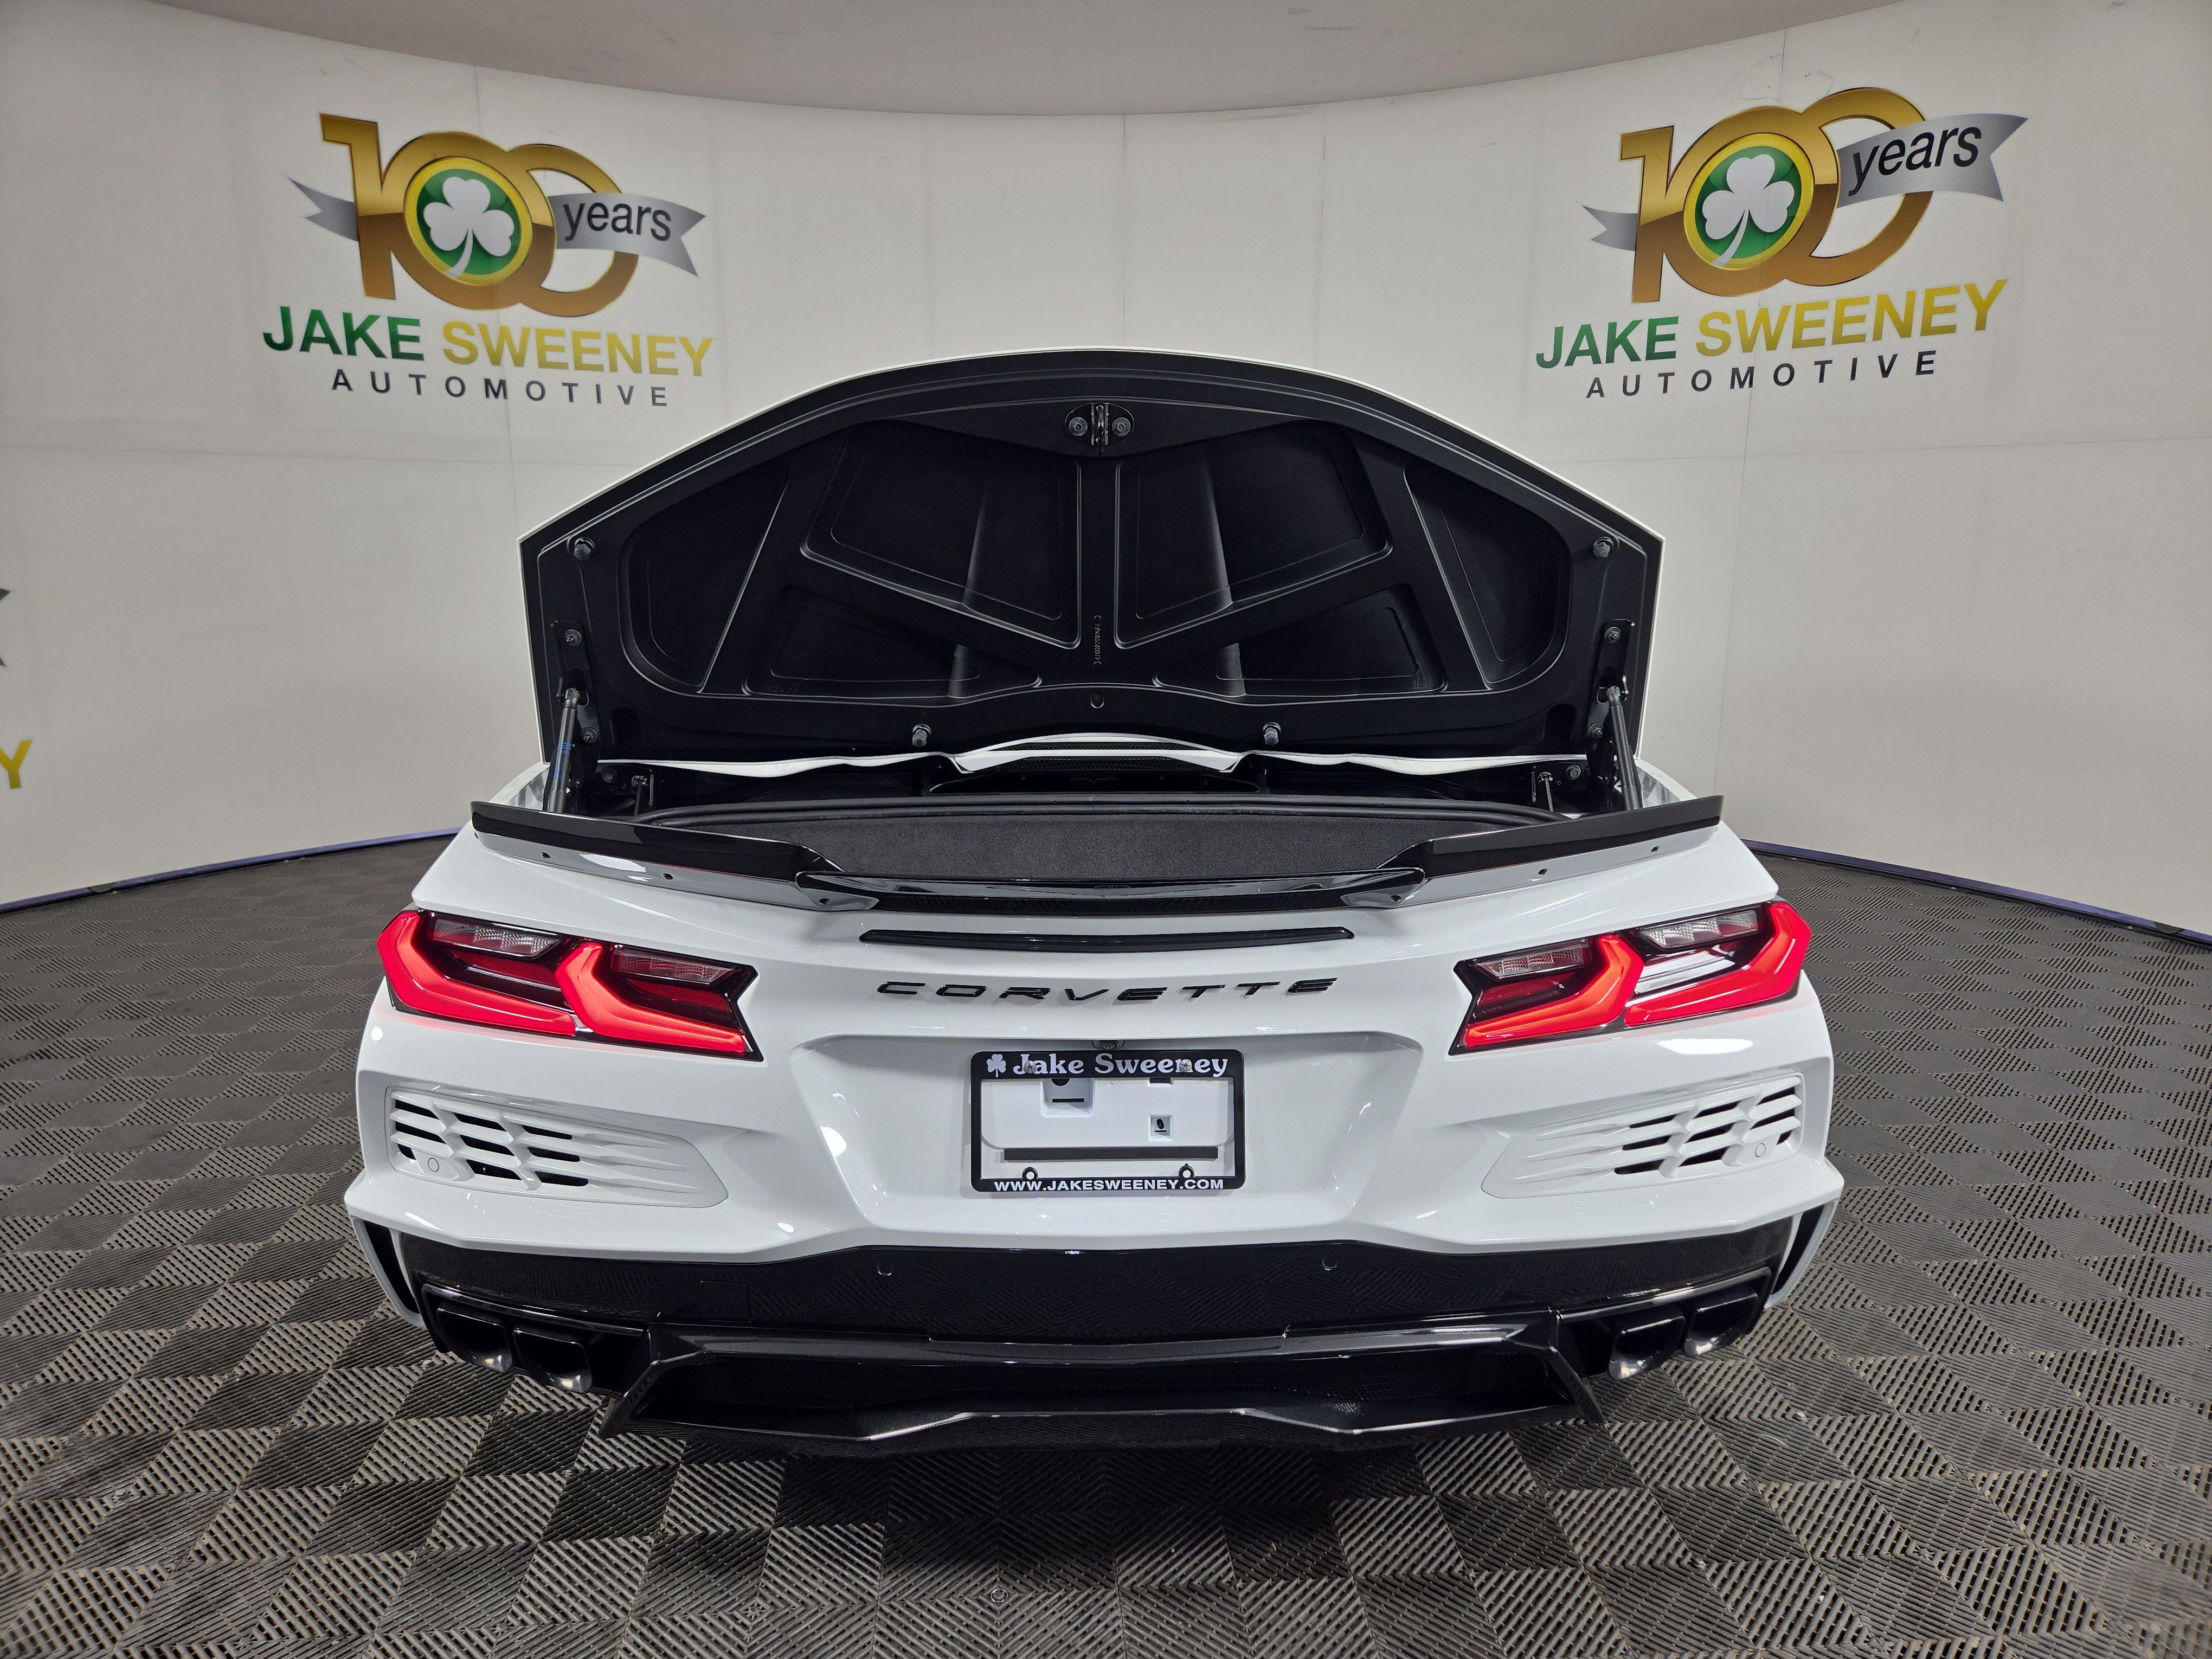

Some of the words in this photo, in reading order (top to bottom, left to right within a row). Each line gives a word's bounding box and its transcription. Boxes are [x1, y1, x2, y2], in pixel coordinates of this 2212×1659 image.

[319, 113, 639, 317] 100
[563, 201, 672, 242] years
[1620, 87, 1933, 304] 100
[1848, 126, 1982, 197] years
[263, 306, 425, 362] JAKE
[443, 321, 713, 377] SWEENEY
[1536, 316, 1680, 369] JAKE
[1695, 279, 2008, 357] SWEENEY
[332, 369, 668, 407] AUTOMOTIVE
[1586, 350, 1938, 398] AUTOMOTIVE
[877, 978, 1339, 1002] CORVETTE
[1013, 1053, 1085, 1075] Jake
[994, 1179, 1224, 1192] WWW.JAKESWEENEY.COM
